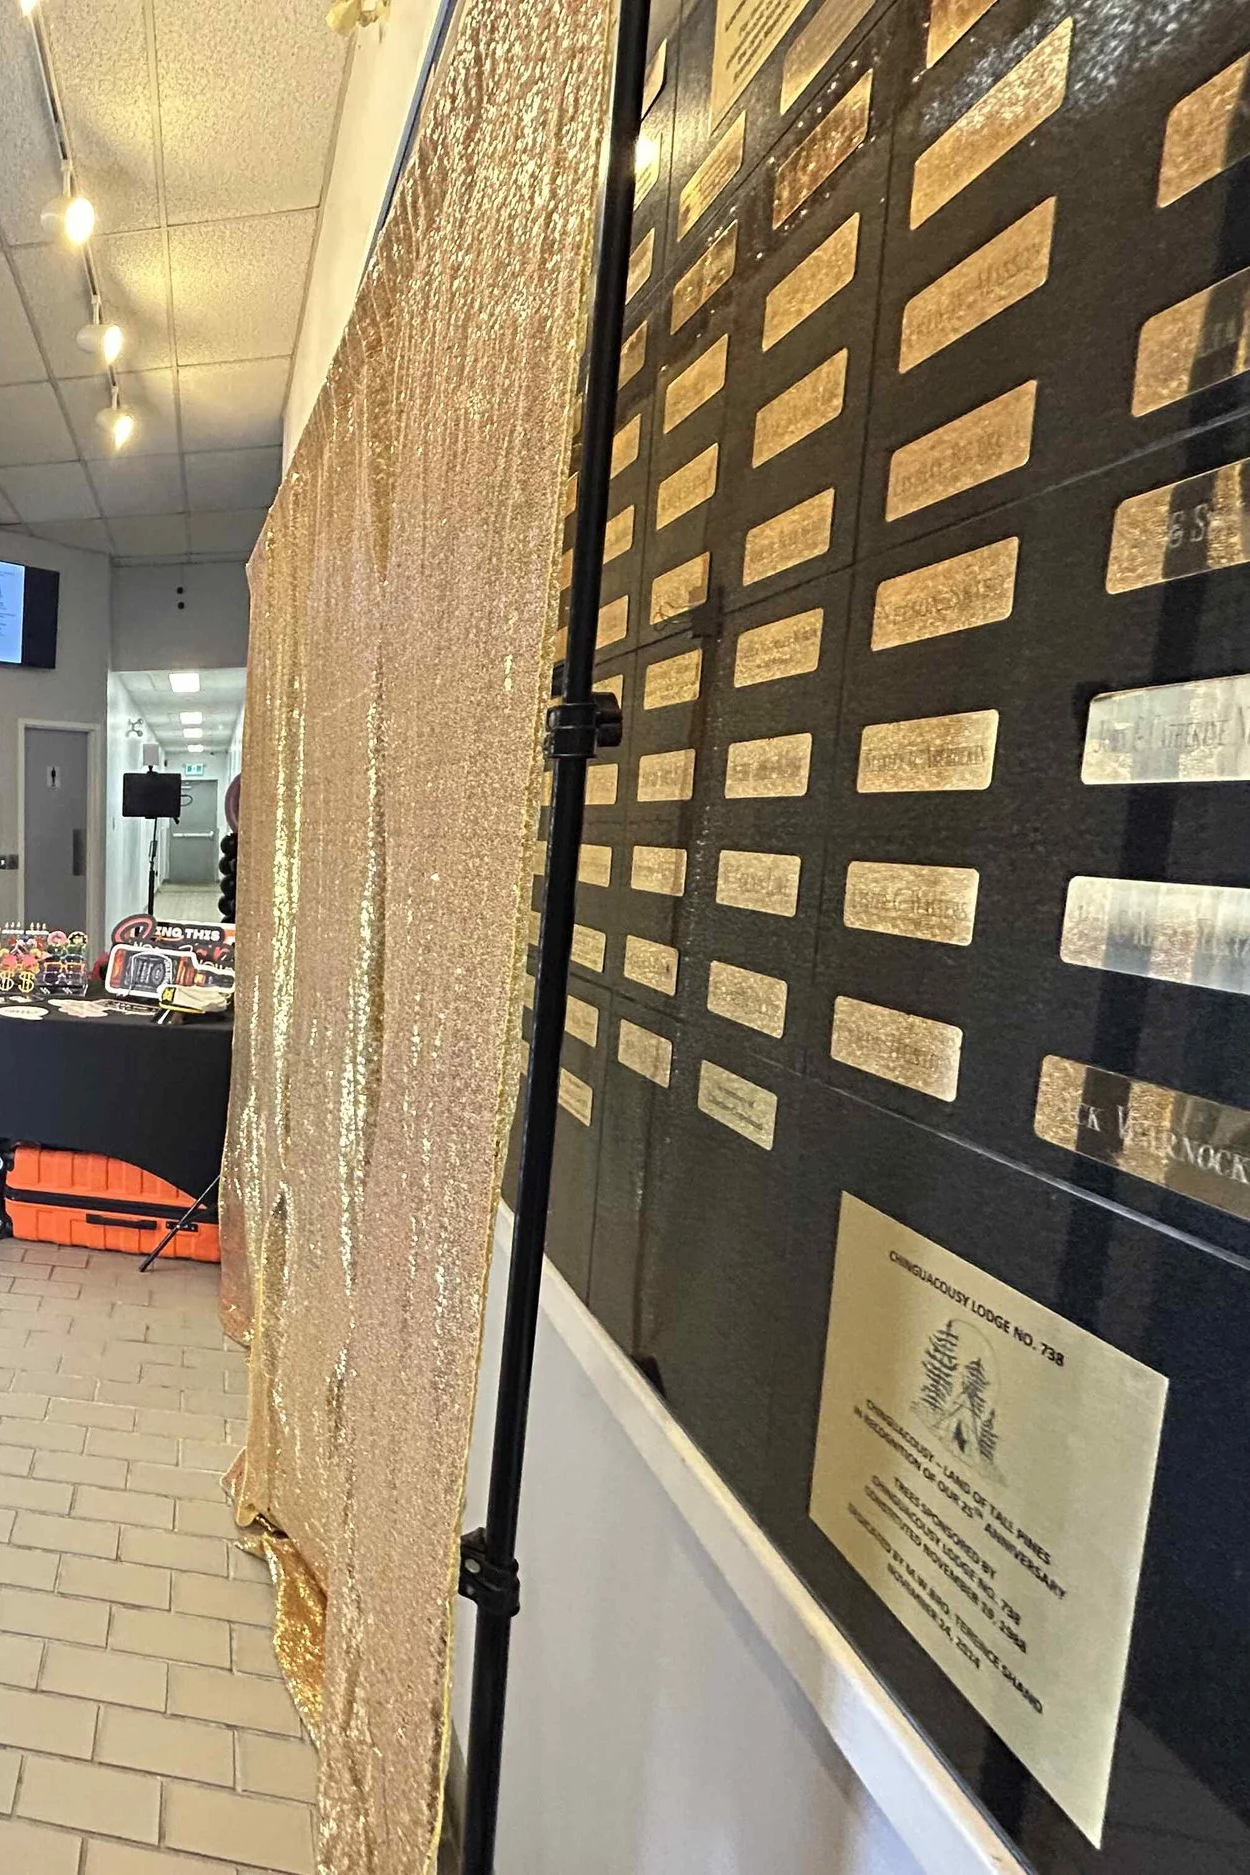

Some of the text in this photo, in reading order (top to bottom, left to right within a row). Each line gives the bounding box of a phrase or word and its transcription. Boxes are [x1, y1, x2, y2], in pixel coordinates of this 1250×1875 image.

[185, 928, 220, 941] THIS
[889, 1250, 1064, 1367] CHINGUACOUSY LODGE NO. 738
[923, 1467, 936, 1483] OF
[937, 1480, 961, 1507] OUR
[984, 1523, 1067, 1600] ANNIVERSARY
[943, 1465, 972, 1497] LAND
[972, 1491, 989, 1509] OF
[989, 1502, 1014, 1534] TALL
[1015, 1528, 1052, 1566] PINES
[980, 1558, 997, 1581] BY
[1000, 1598, 1022, 1626] 738
